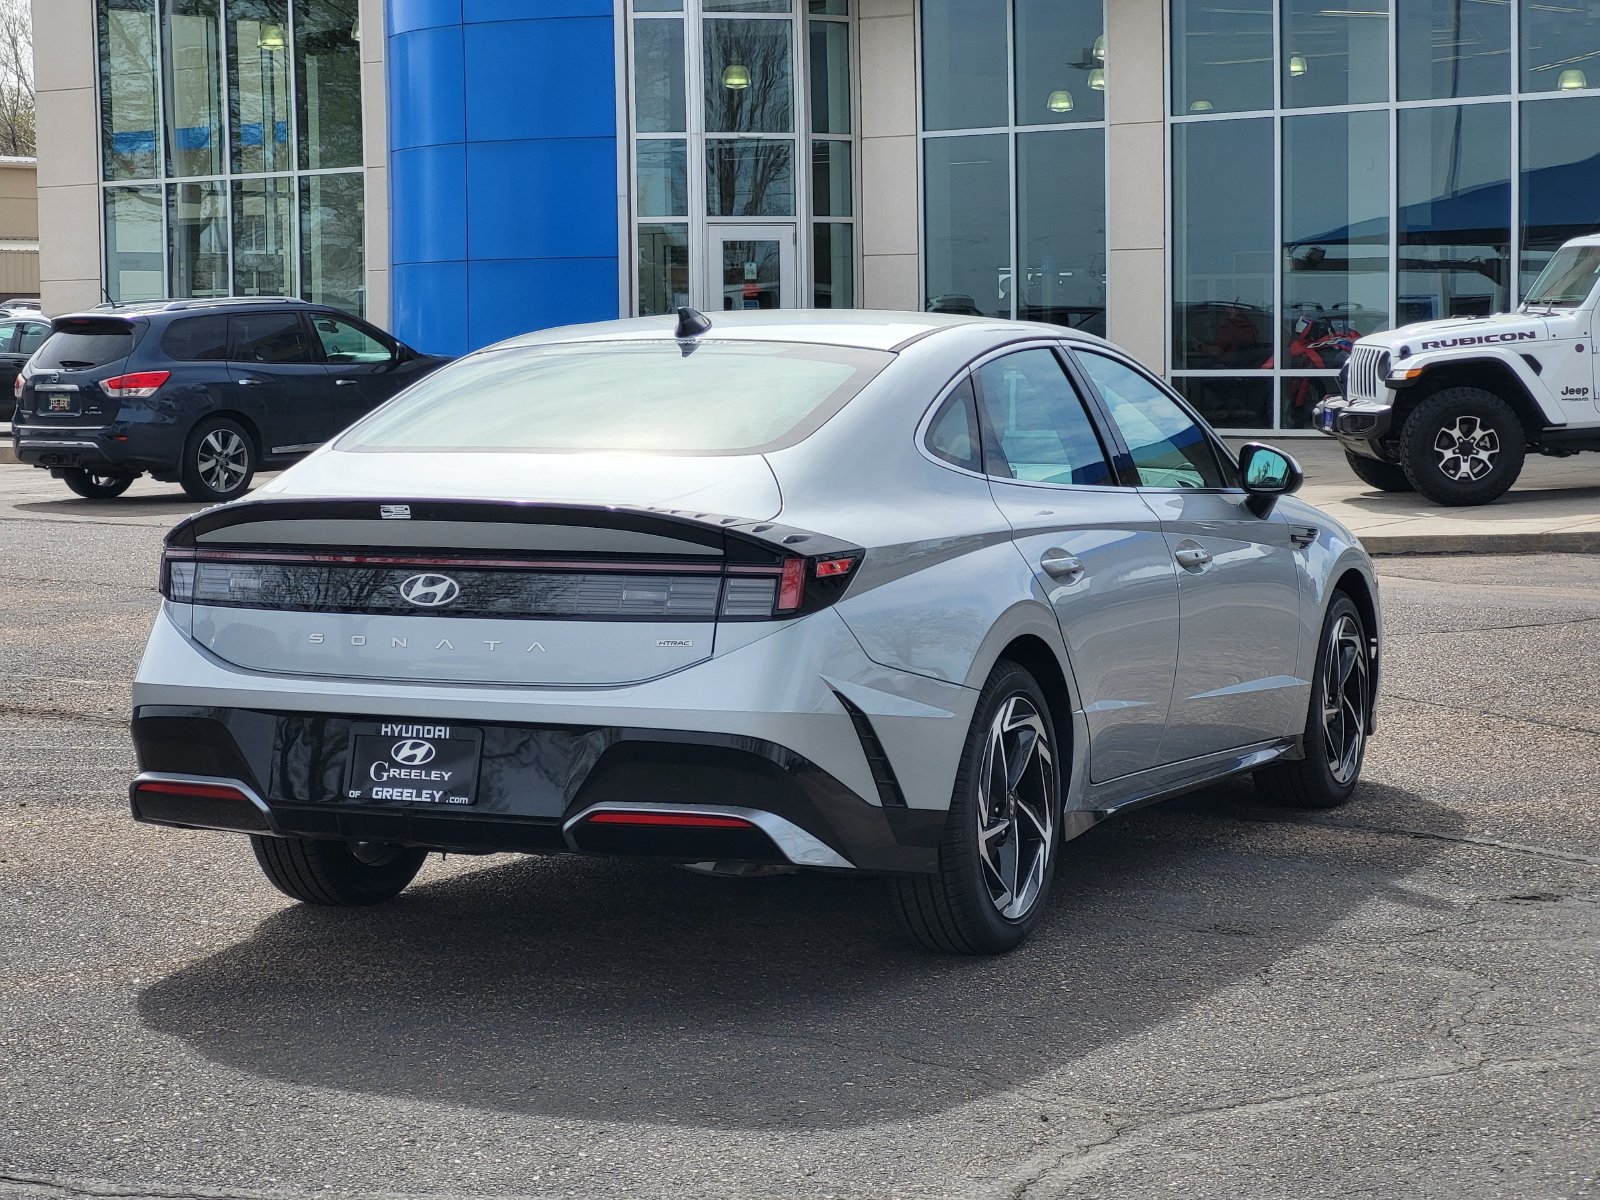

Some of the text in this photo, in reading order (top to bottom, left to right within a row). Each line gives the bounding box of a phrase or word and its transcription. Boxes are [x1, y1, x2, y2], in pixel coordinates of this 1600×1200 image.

[1421, 331, 1536, 350] RUBICON
[1561, 386, 1589, 396] Jeep
[308, 633, 547, 653] SONATA
[381, 723, 450, 739] HYUNDAI
[370, 760, 453, 782] GREELEY
[349, 790, 361, 798] OF
[372, 787, 444, 803] GREELEY
